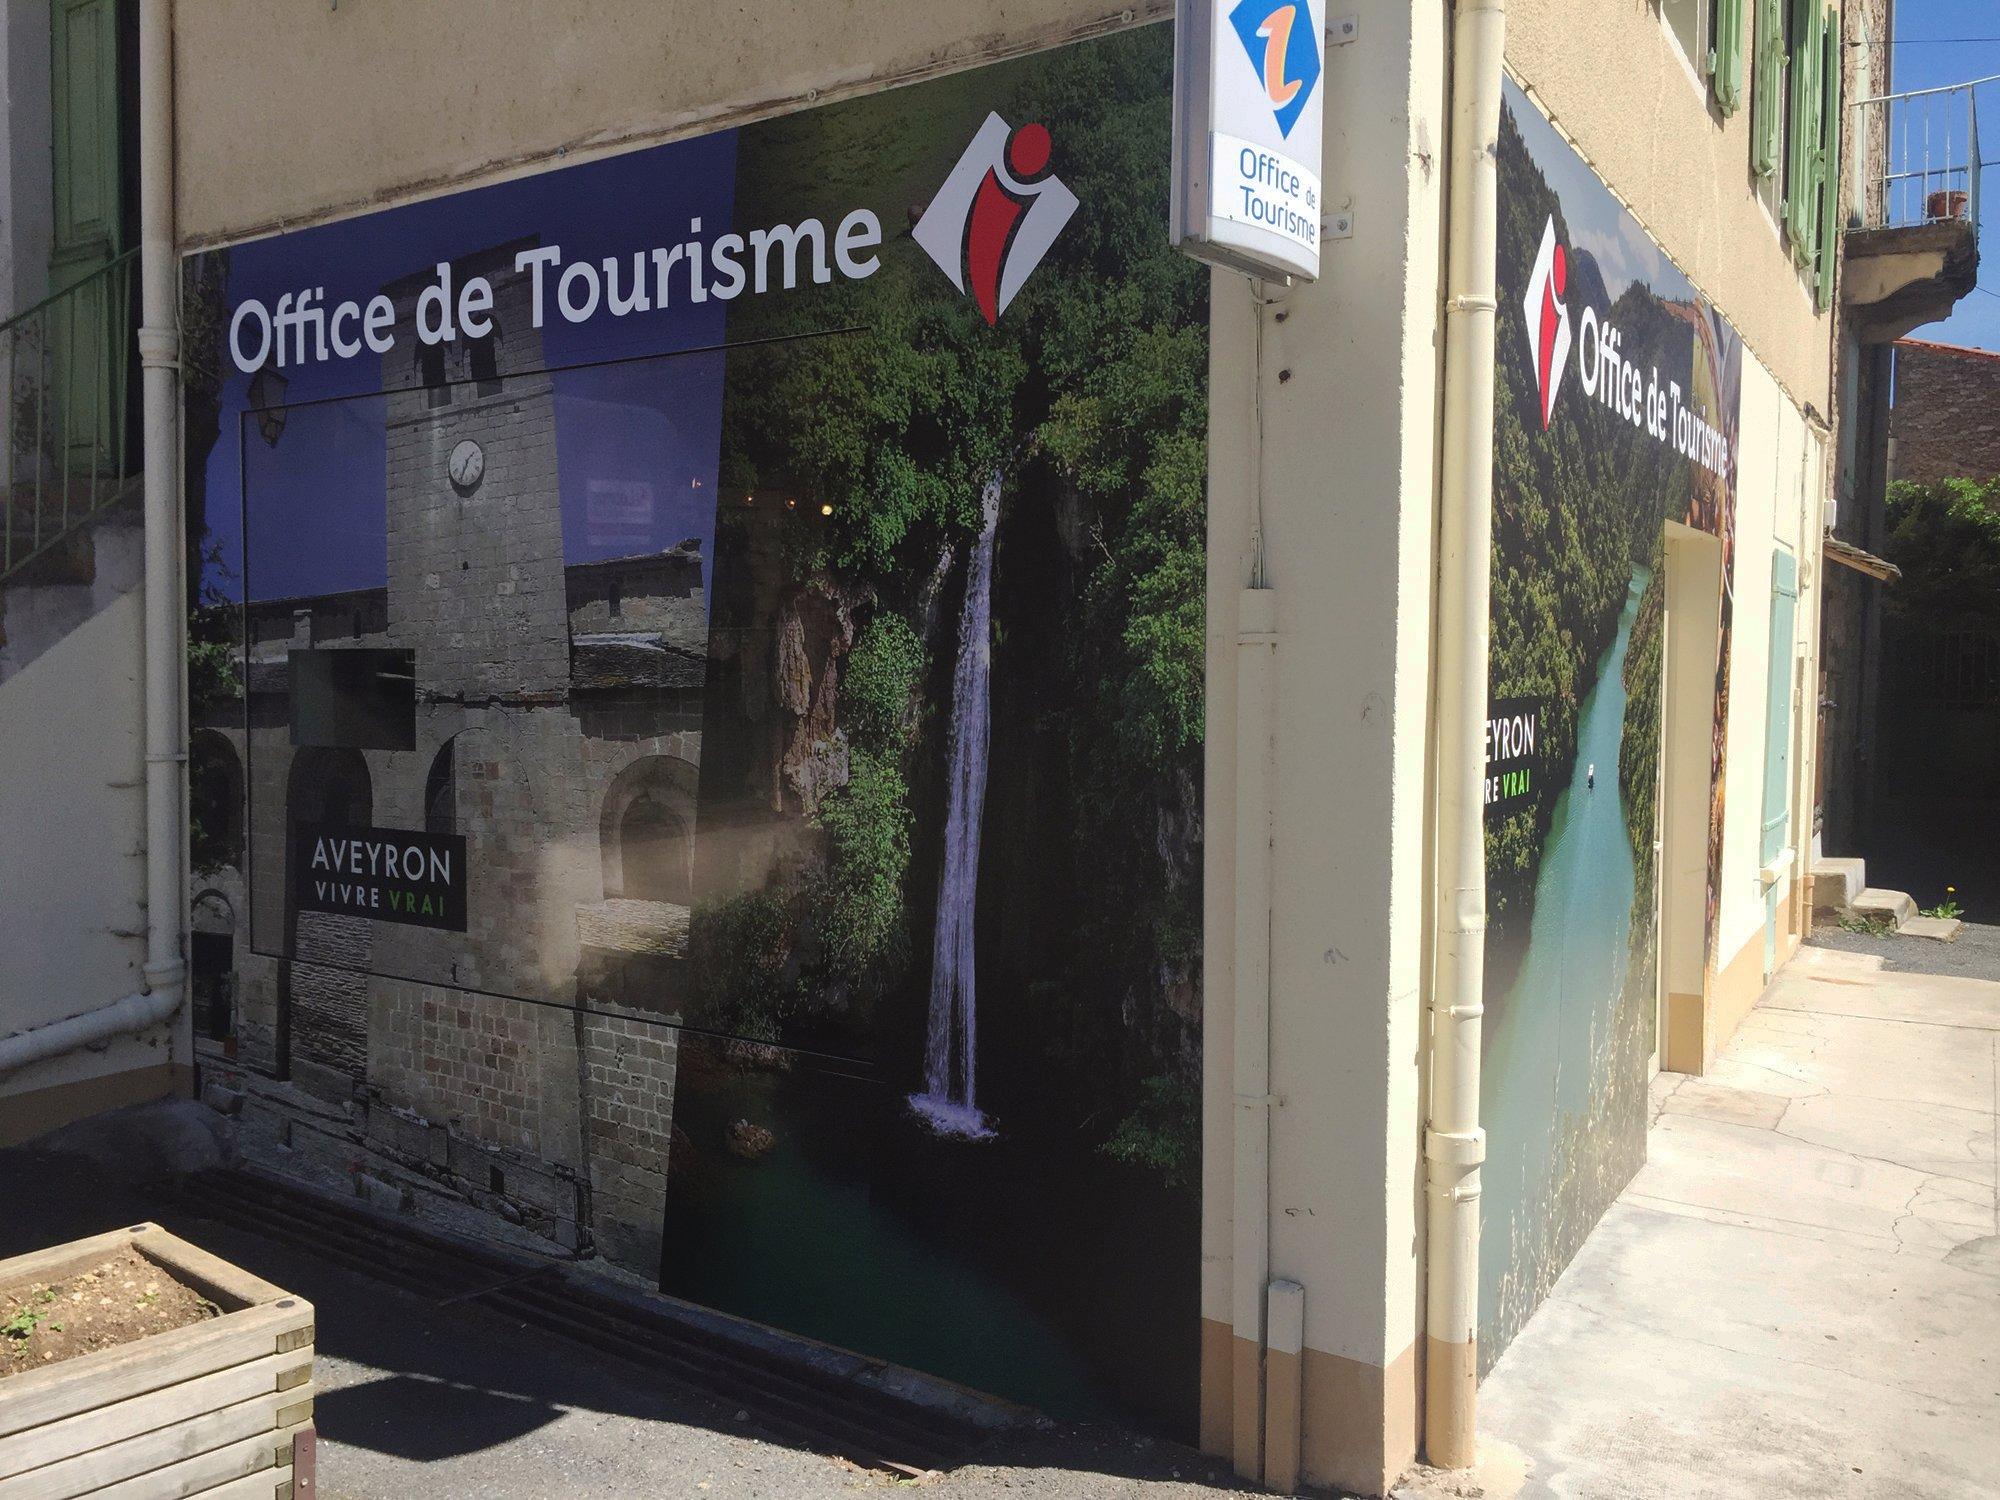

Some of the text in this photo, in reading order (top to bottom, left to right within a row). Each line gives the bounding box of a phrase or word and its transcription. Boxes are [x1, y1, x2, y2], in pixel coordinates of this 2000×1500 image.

[1239, 148, 1315, 209] Office de
[1239, 185, 1315, 244] Tourisme
[230, 208, 882, 372] Office de Tourisme
[1579, 305, 1728, 479] Office de Tourisme
[1503, 769, 1529, 798] VRAI
[311, 836, 450, 885] AVEYRON
[315, 880, 444, 917] VIVRE VRAI
